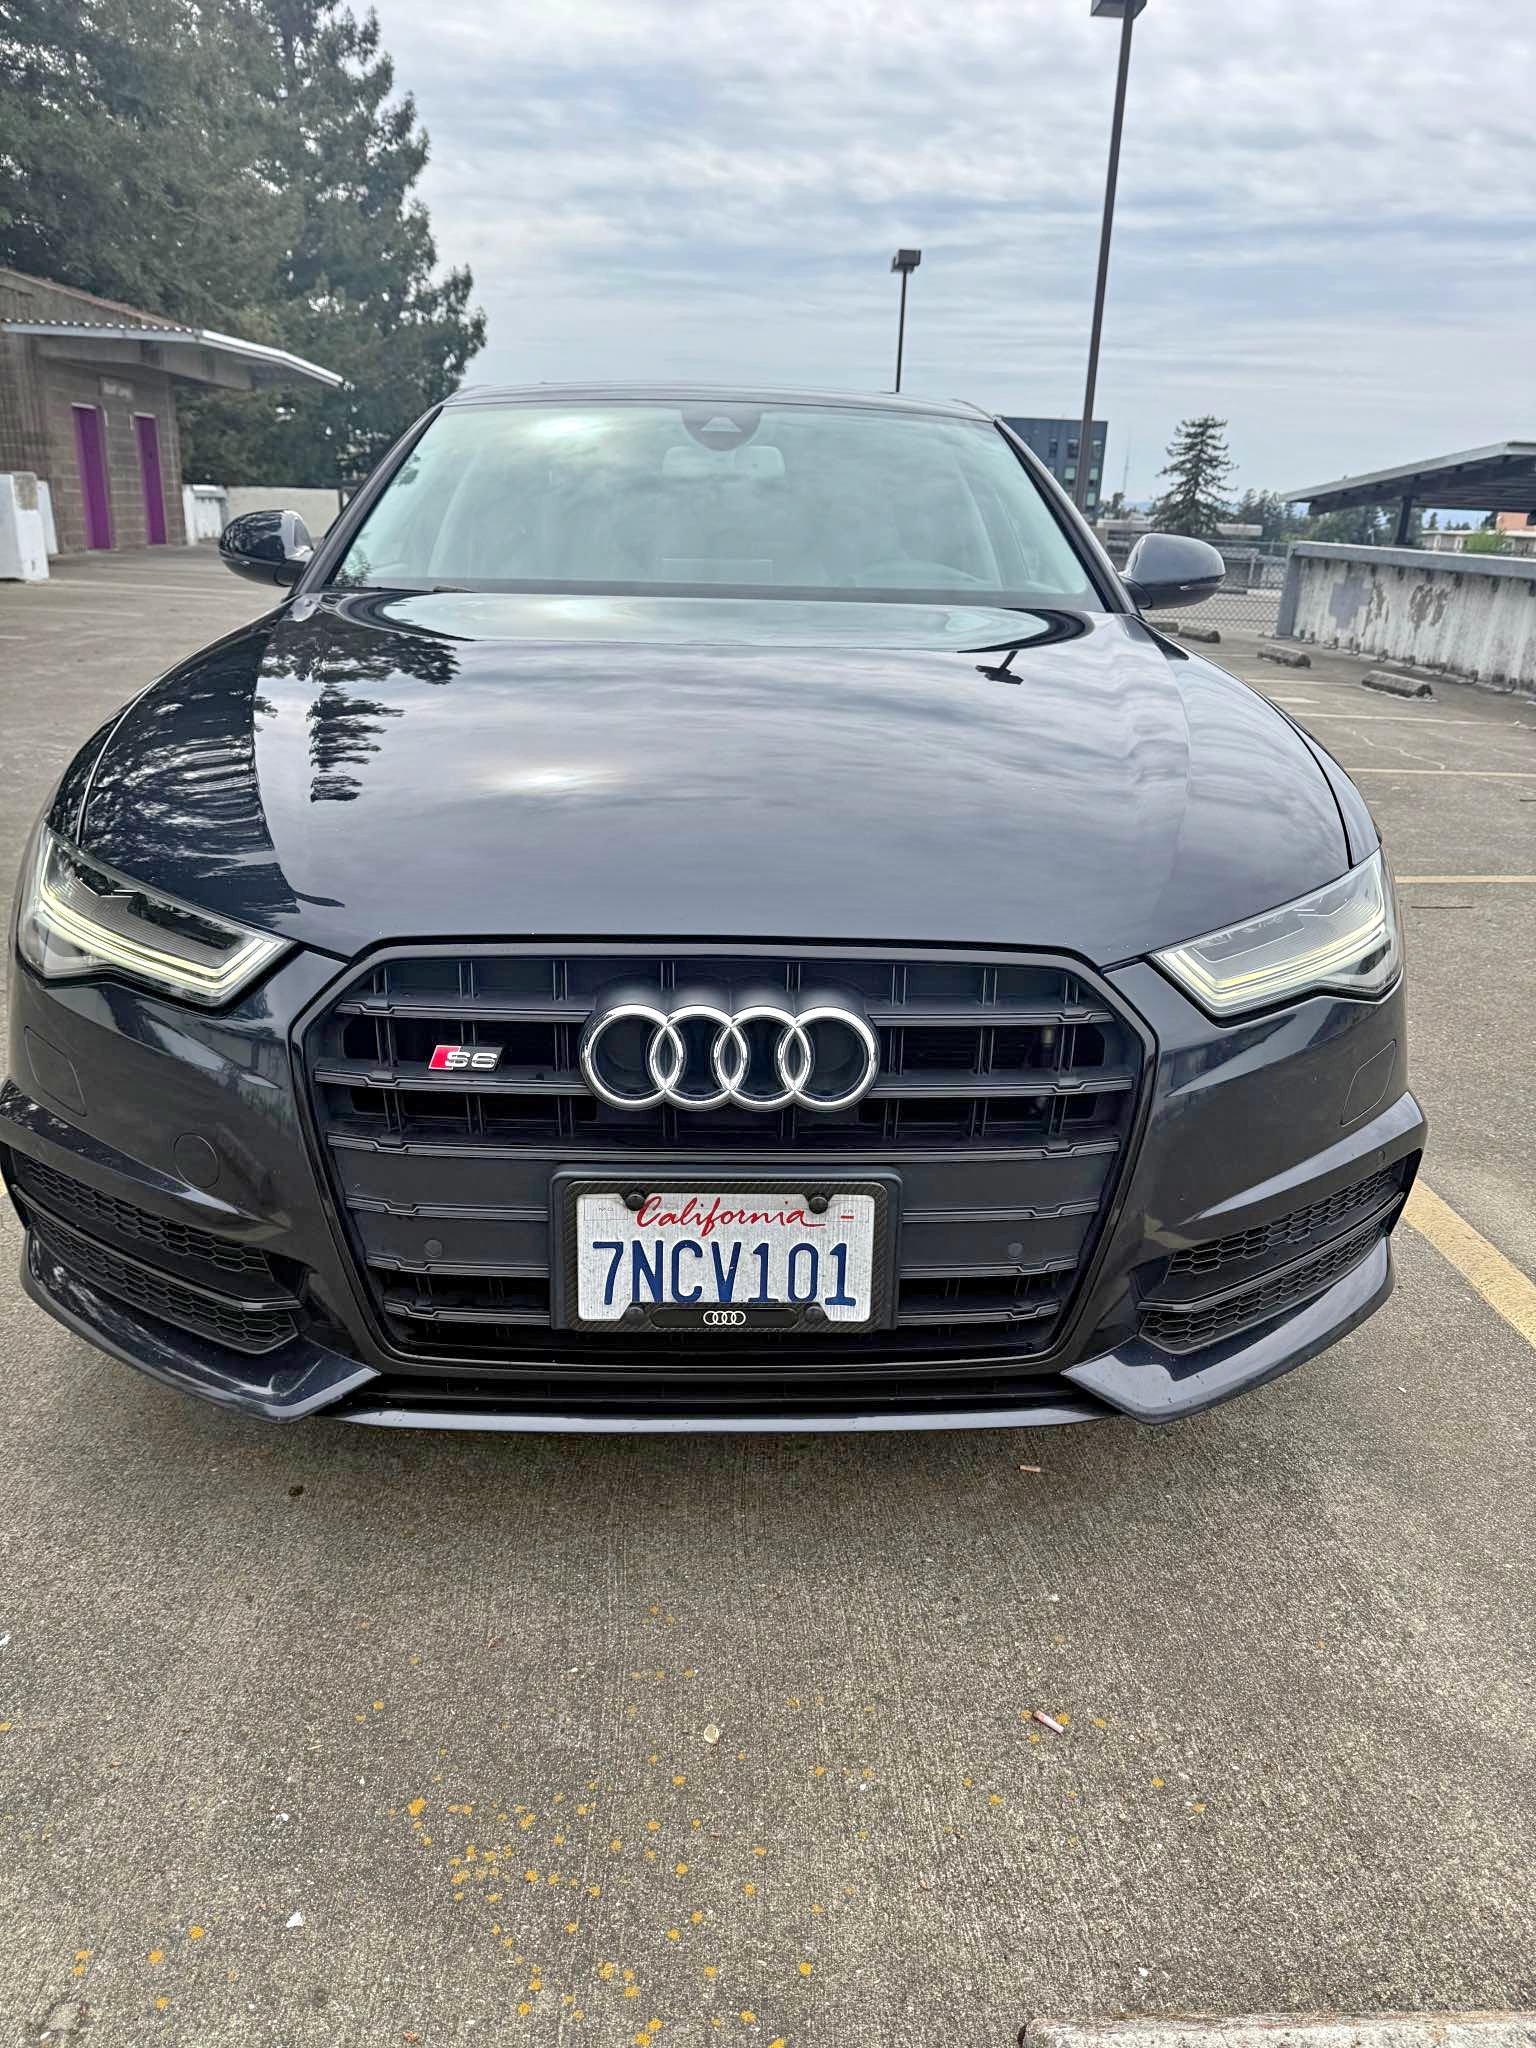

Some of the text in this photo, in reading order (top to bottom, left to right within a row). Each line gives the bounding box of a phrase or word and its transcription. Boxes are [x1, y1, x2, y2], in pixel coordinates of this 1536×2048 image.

[445, 1051, 498, 1068] S6
[637, 1196, 825, 1237] California
[592, 1240, 856, 1307] 7NCV101
